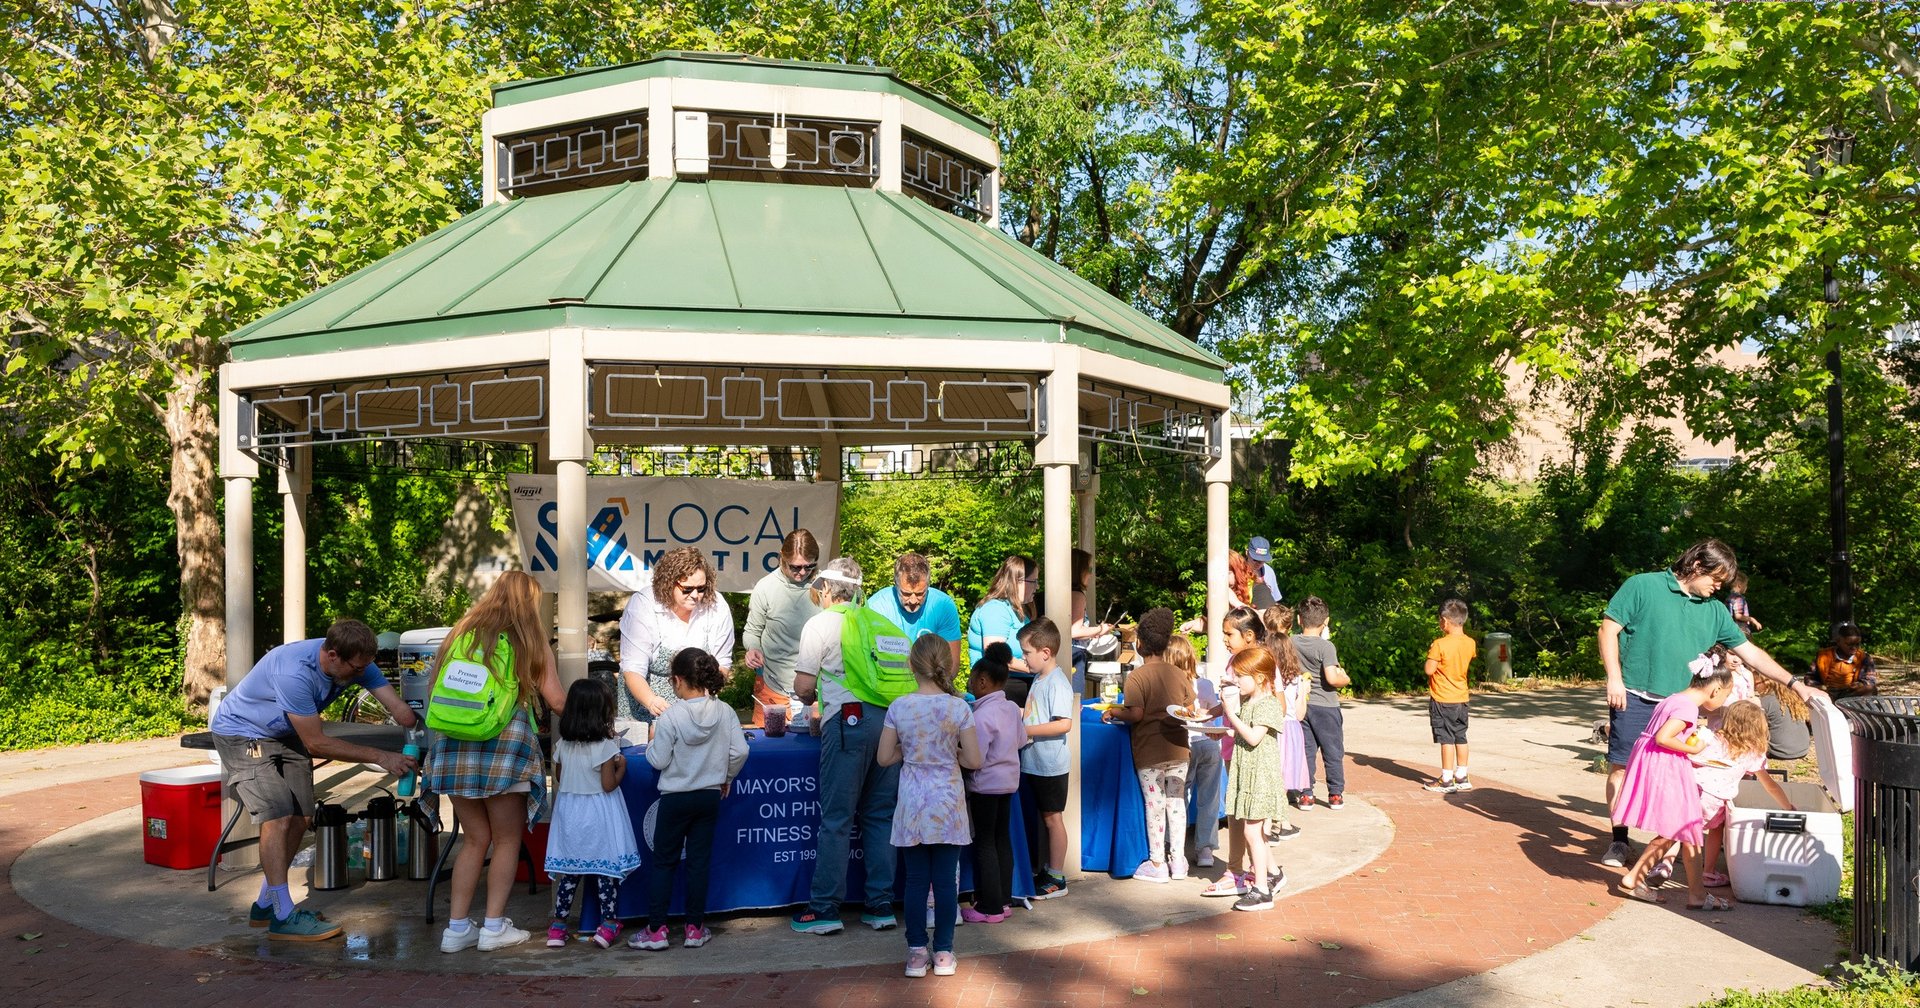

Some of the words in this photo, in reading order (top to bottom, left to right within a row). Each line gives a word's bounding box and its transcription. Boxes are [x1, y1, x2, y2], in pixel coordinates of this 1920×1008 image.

[644, 549, 781, 574] MTIO
[448, 675, 483, 687] Kindergarten
[736, 776, 816, 795] MAYOR'S
[759, 803, 786, 818] ON
[737, 825, 812, 843] FITNESS
[774, 851, 796, 862] EST
[800, 849, 817, 861] 199
